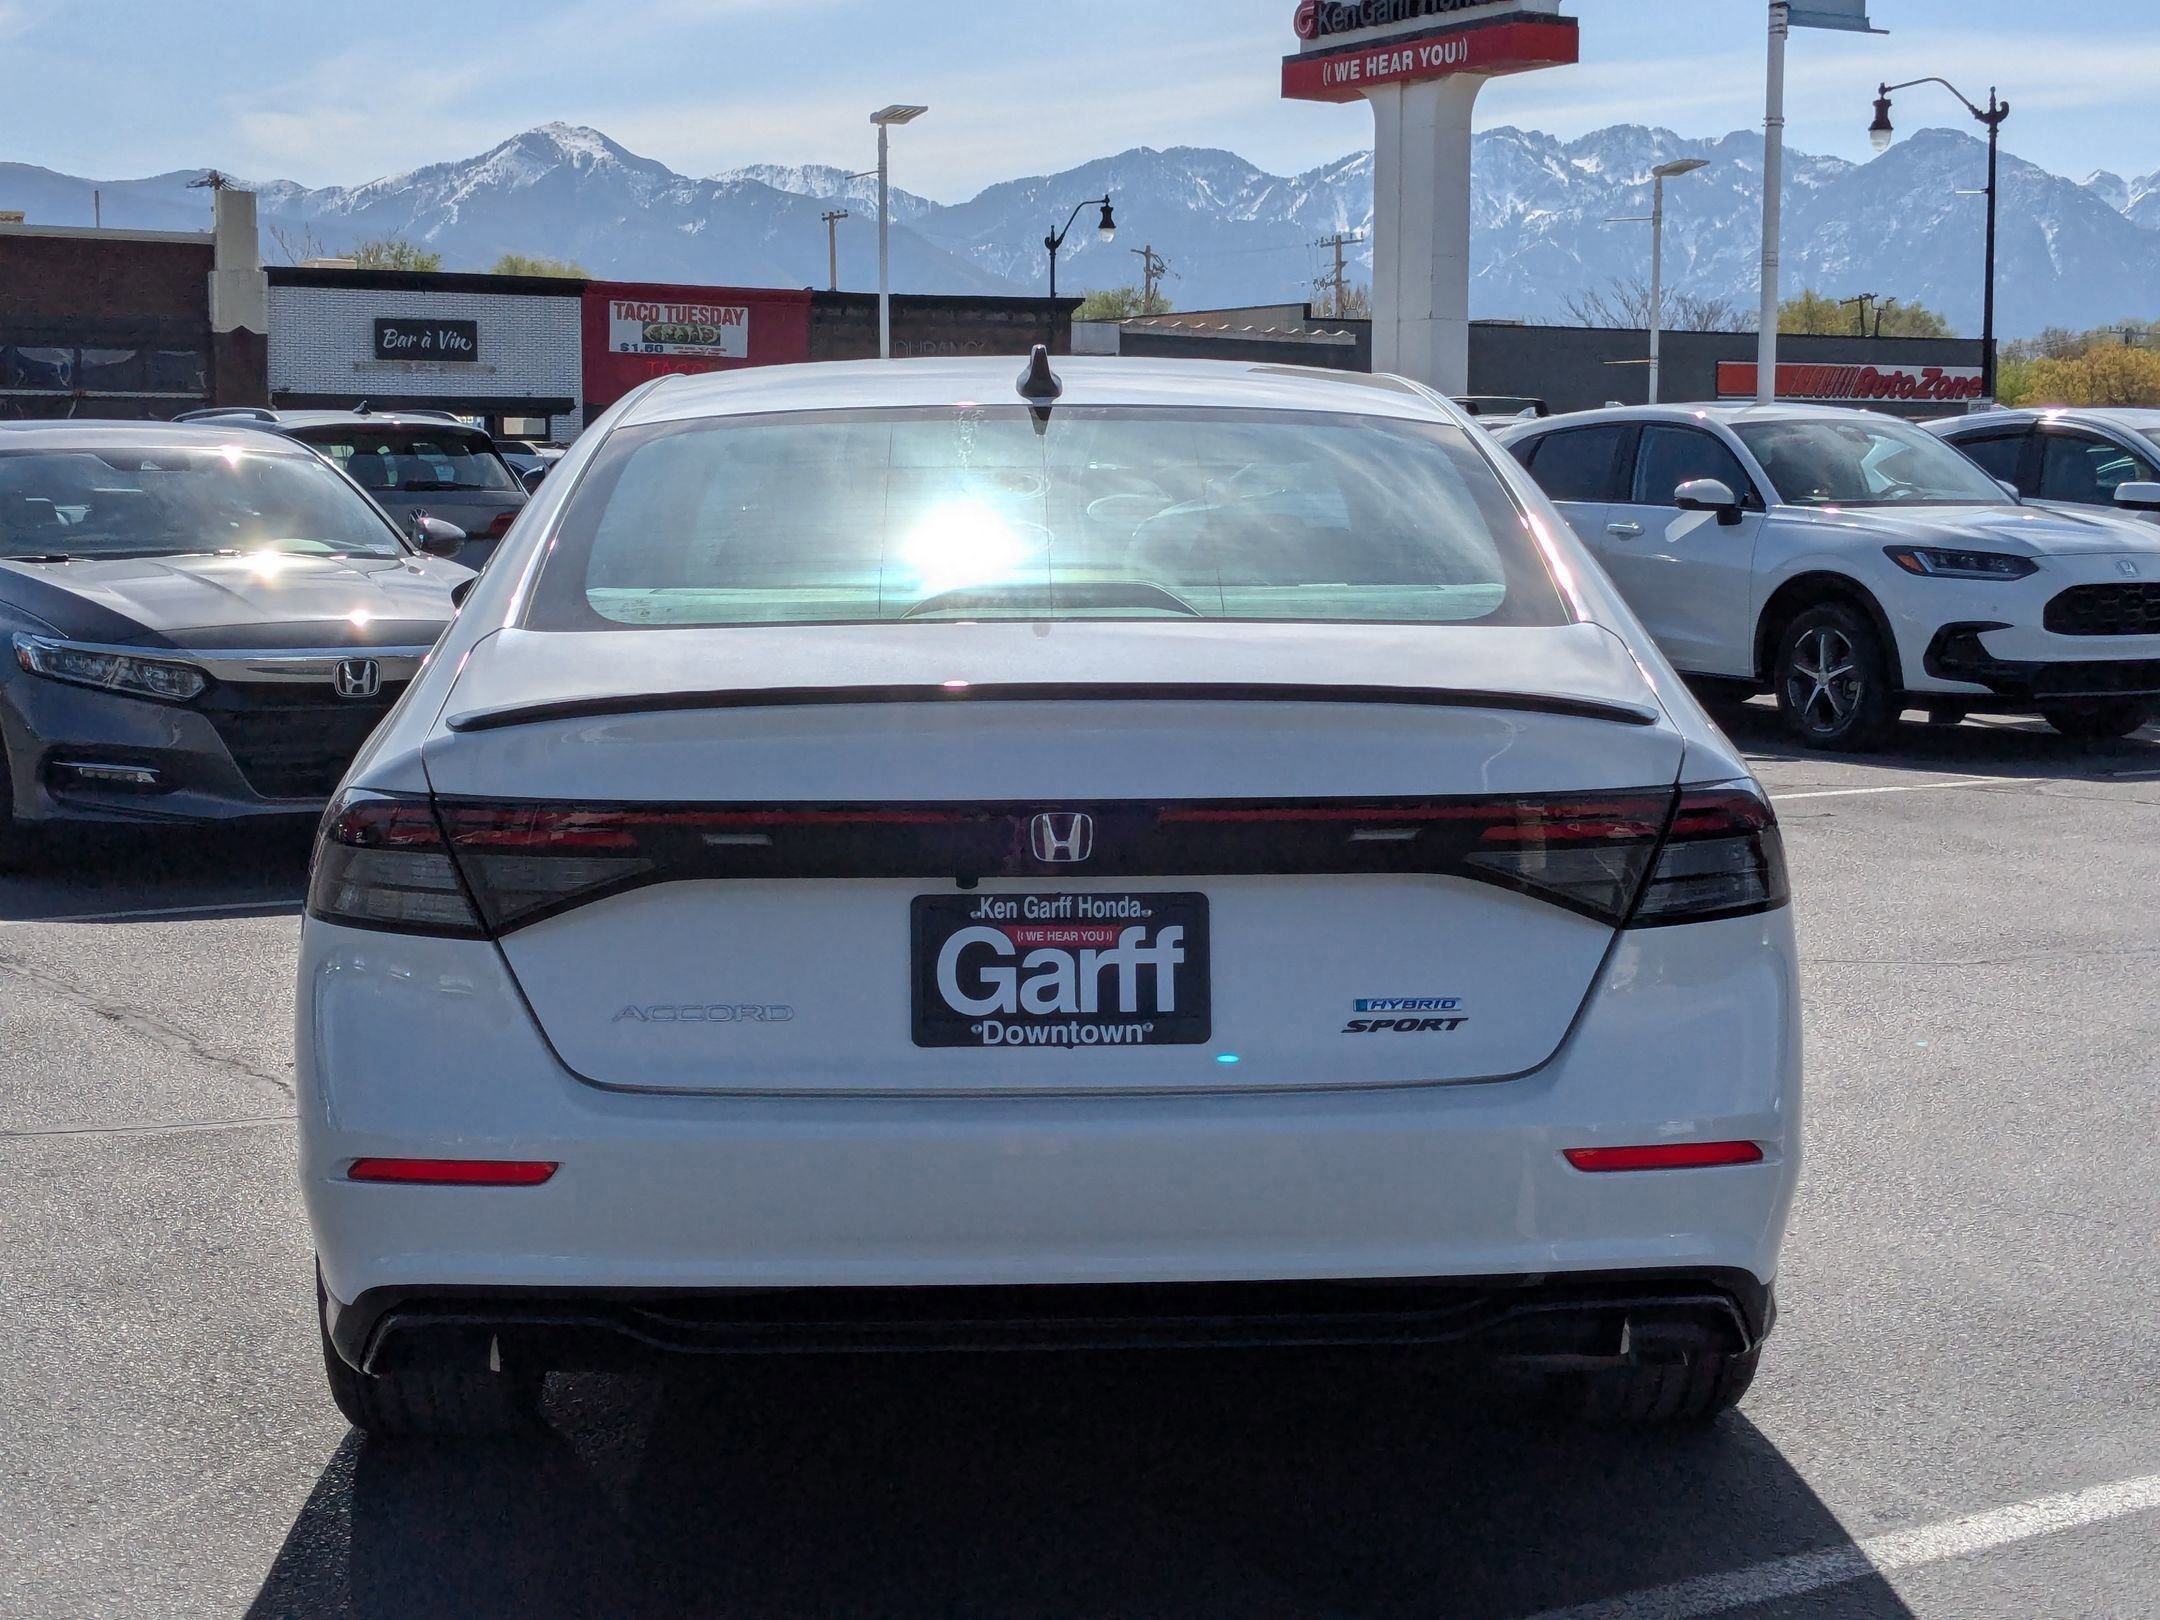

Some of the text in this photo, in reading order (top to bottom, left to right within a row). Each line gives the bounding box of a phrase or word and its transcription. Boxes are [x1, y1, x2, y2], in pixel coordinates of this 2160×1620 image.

[1334, 42, 1456, 82] WE HEAR YOU
[614, 302, 745, 327] TACO TUESDAY
[382, 328, 473, 350] Bar à Vin
[619, 342, 664, 353] $1.50
[1854, 366, 1983, 400] AutoZone
[980, 896, 1141, 919] Ken Garff Honda
[1026, 930, 1105, 942] WE HEAR YOU
[937, 925, 1185, 1016] Garff
[611, 1004, 795, 1023] ACCORD
[1369, 998, 1457, 1010] HYBRID
[982, 1020, 1144, 1044] Downtown
[1341, 1017, 1469, 1034] SPORT
